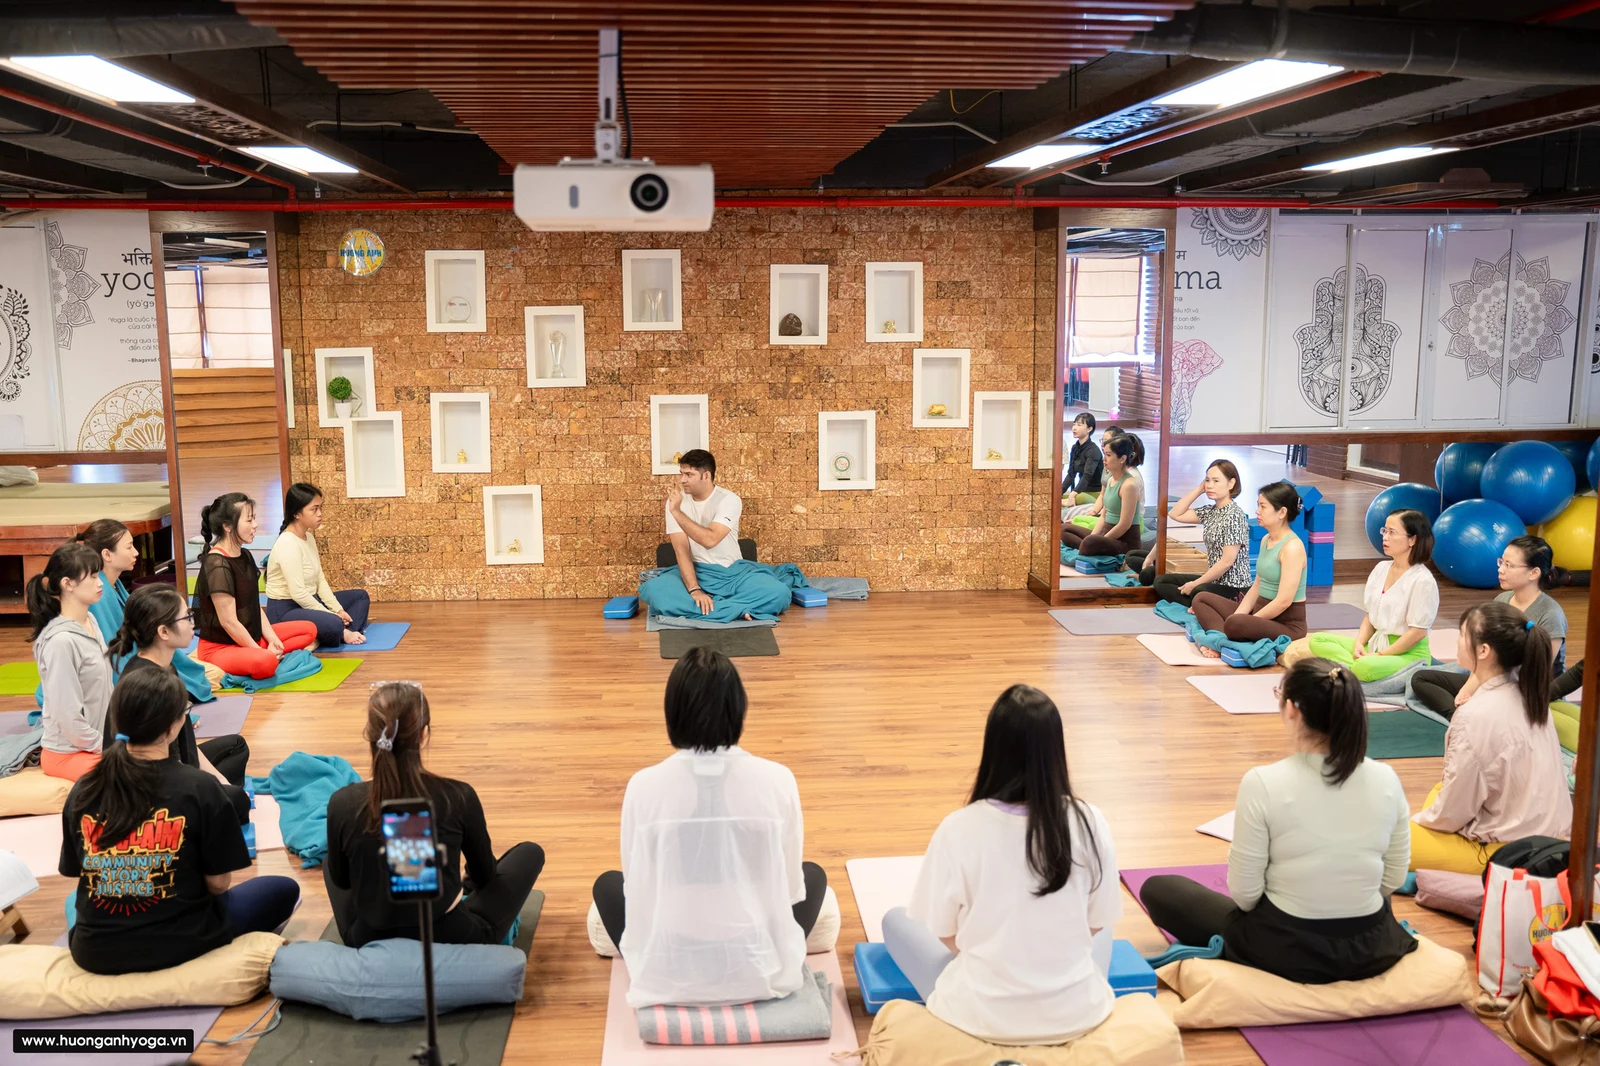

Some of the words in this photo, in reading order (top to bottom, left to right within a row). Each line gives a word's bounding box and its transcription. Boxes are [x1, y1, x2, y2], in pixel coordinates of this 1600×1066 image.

[100, 271, 155, 298] yog
[83, 854, 174, 869] COMMUNITY
[101, 869, 150, 882] STORY
[97, 882, 153, 895] JUSTICE
